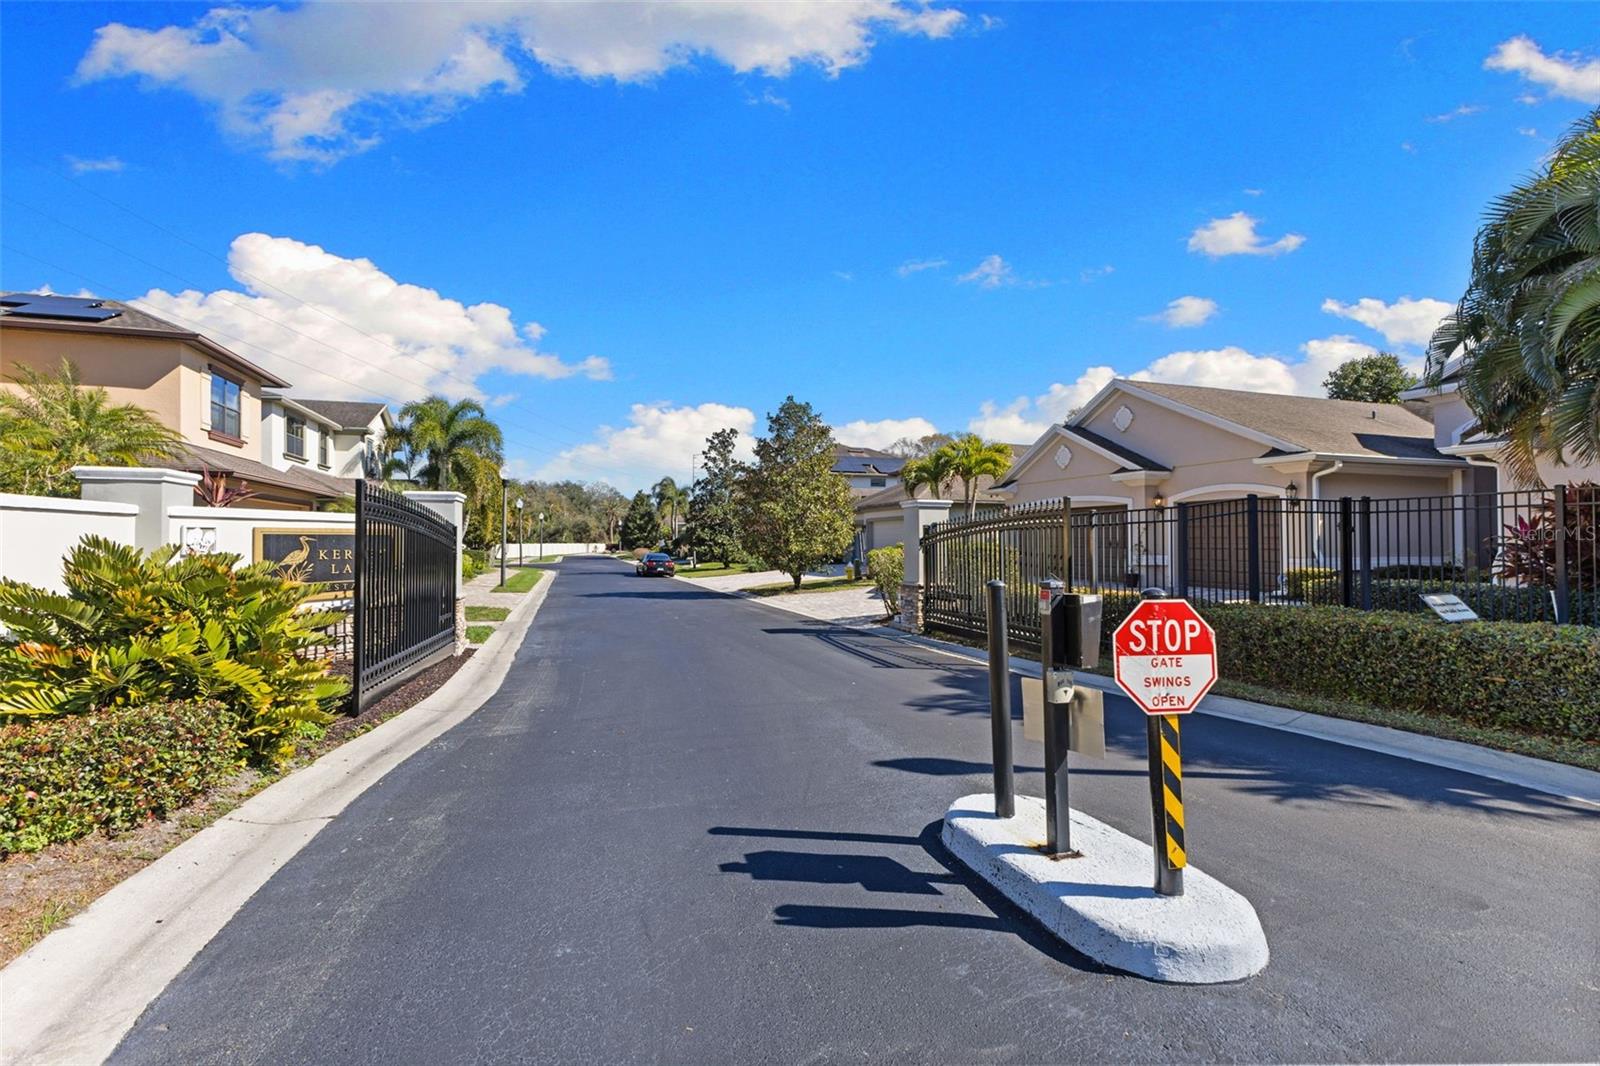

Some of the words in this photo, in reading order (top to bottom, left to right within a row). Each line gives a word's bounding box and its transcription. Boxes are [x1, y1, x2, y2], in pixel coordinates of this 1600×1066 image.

[1129, 619, 1201, 652] STOP
[1151, 657, 1183, 668] GATE
[1144, 676, 1191, 688] SWINGS
[1152, 696, 1185, 707] OPEN
